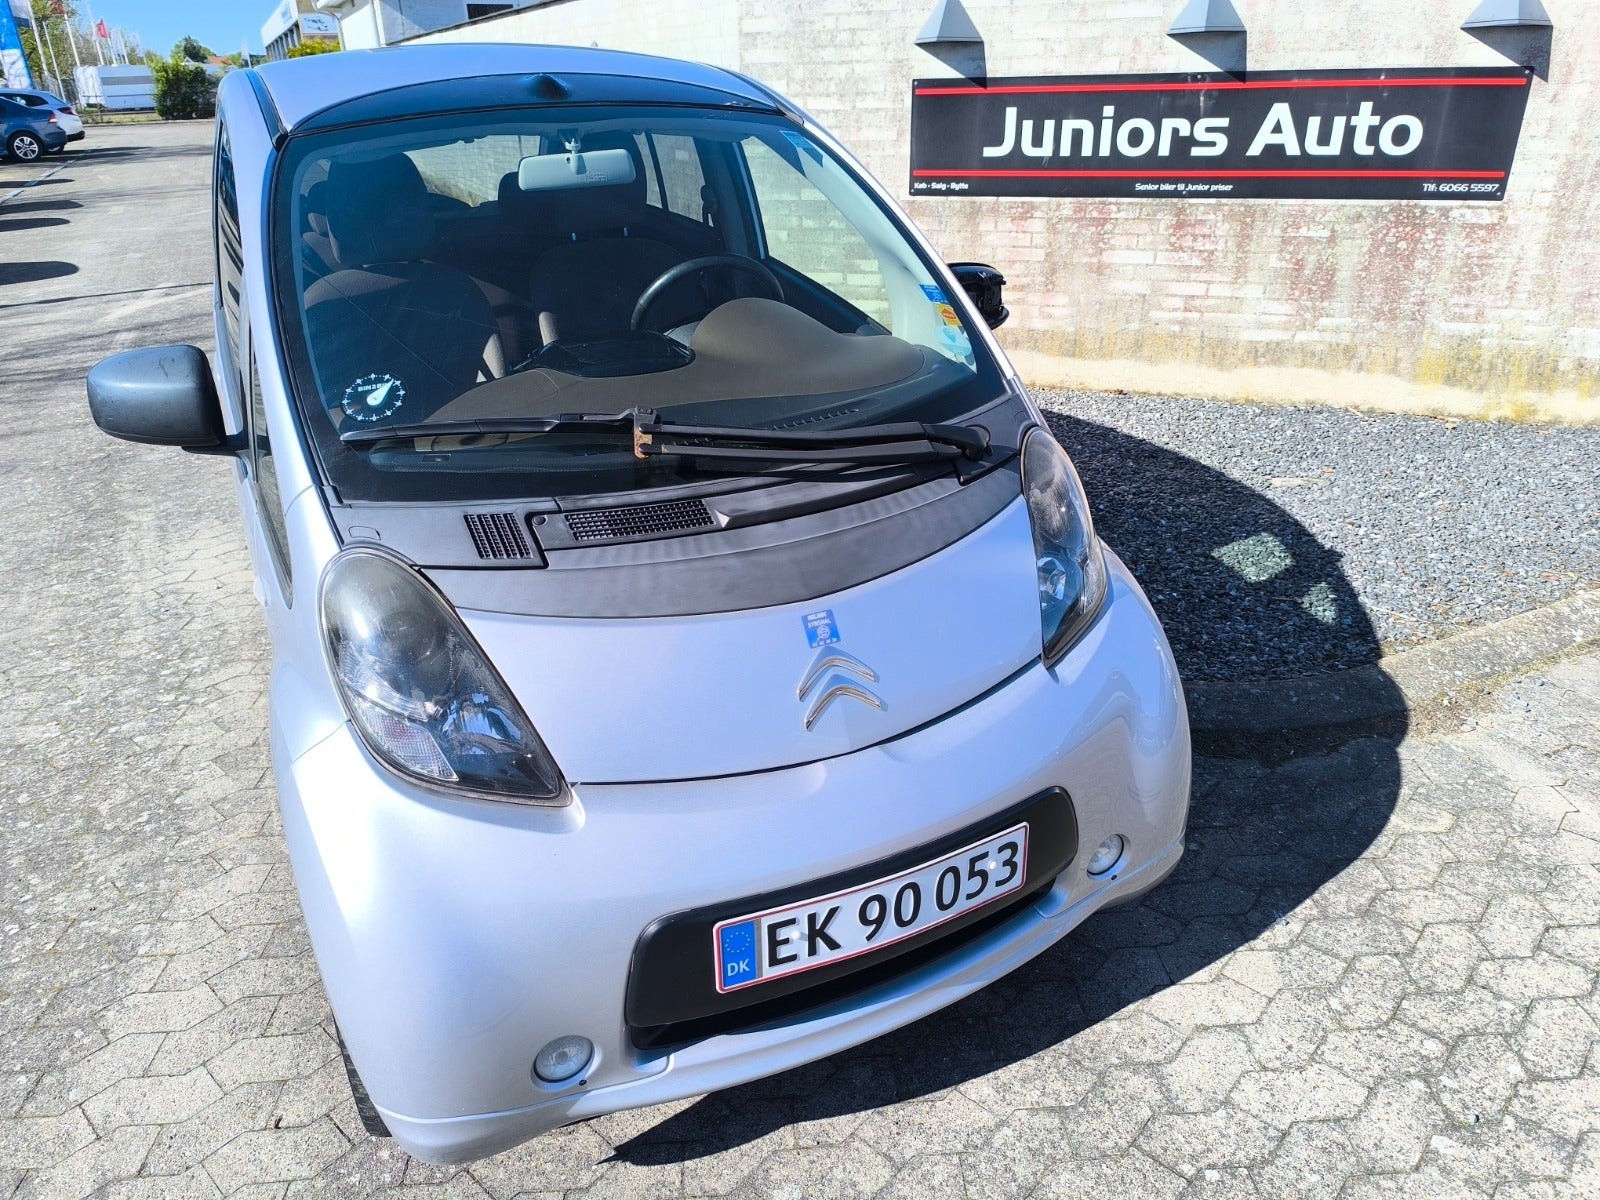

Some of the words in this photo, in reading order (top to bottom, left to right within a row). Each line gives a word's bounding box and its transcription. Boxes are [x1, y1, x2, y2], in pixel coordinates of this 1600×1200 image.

[983, 106, 1230, 157] Juniors
[1246, 101, 1424, 157] Auto
[931, 182, 947, 191] Salg
[1135, 183, 1159, 191] Senior
[1159, 183, 1176, 191] biler
[1177, 183, 1185, 191] til
[1185, 183, 1209, 191] Junior
[1209, 183, 1234, 192] priser
[1438, 183, 1470, 192] 6066
[1469, 183, 1500, 192] 5597
[766, 905, 842, 968] EK
[857, 881, 922, 942] 90
[935, 840, 1019, 912] 053
[727, 958, 750, 977] DK
